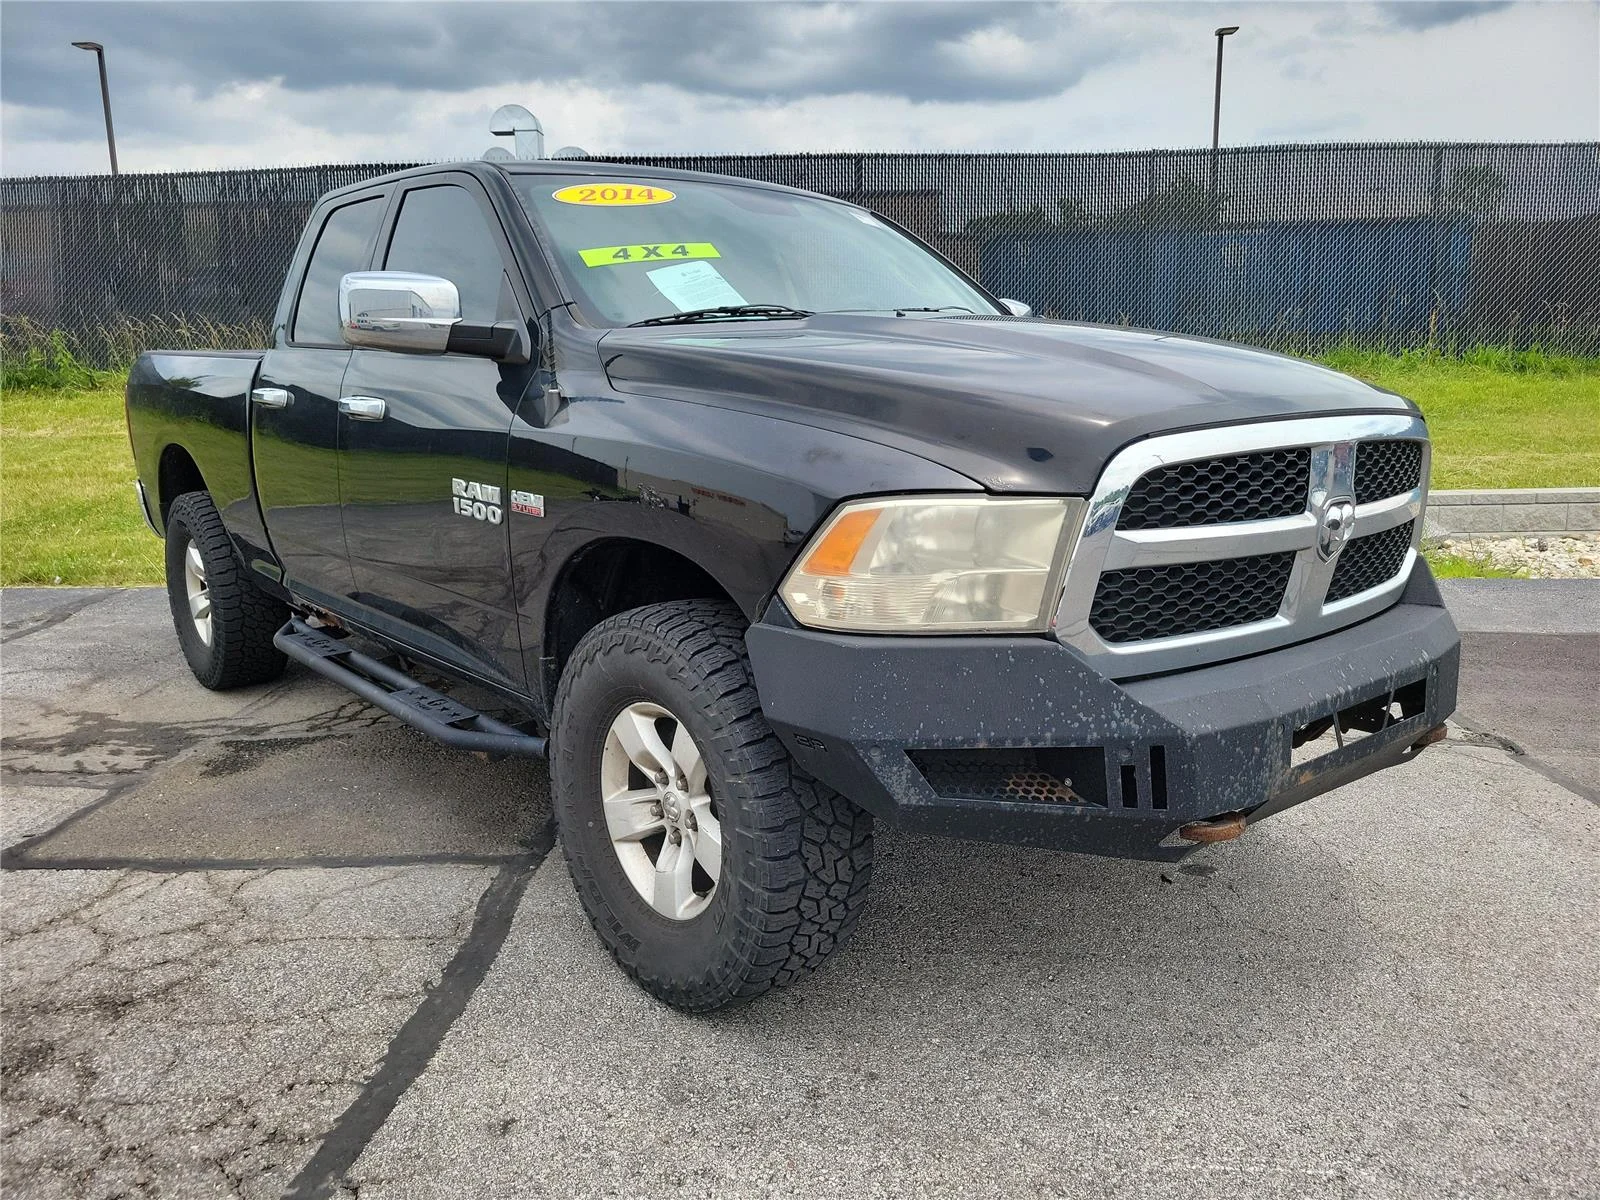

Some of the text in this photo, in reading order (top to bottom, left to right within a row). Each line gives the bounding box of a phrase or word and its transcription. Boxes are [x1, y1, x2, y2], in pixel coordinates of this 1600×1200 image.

[579, 187, 657, 202] 2014
[451, 477, 501, 506] RAM
[452, 496, 504, 526] 1500
